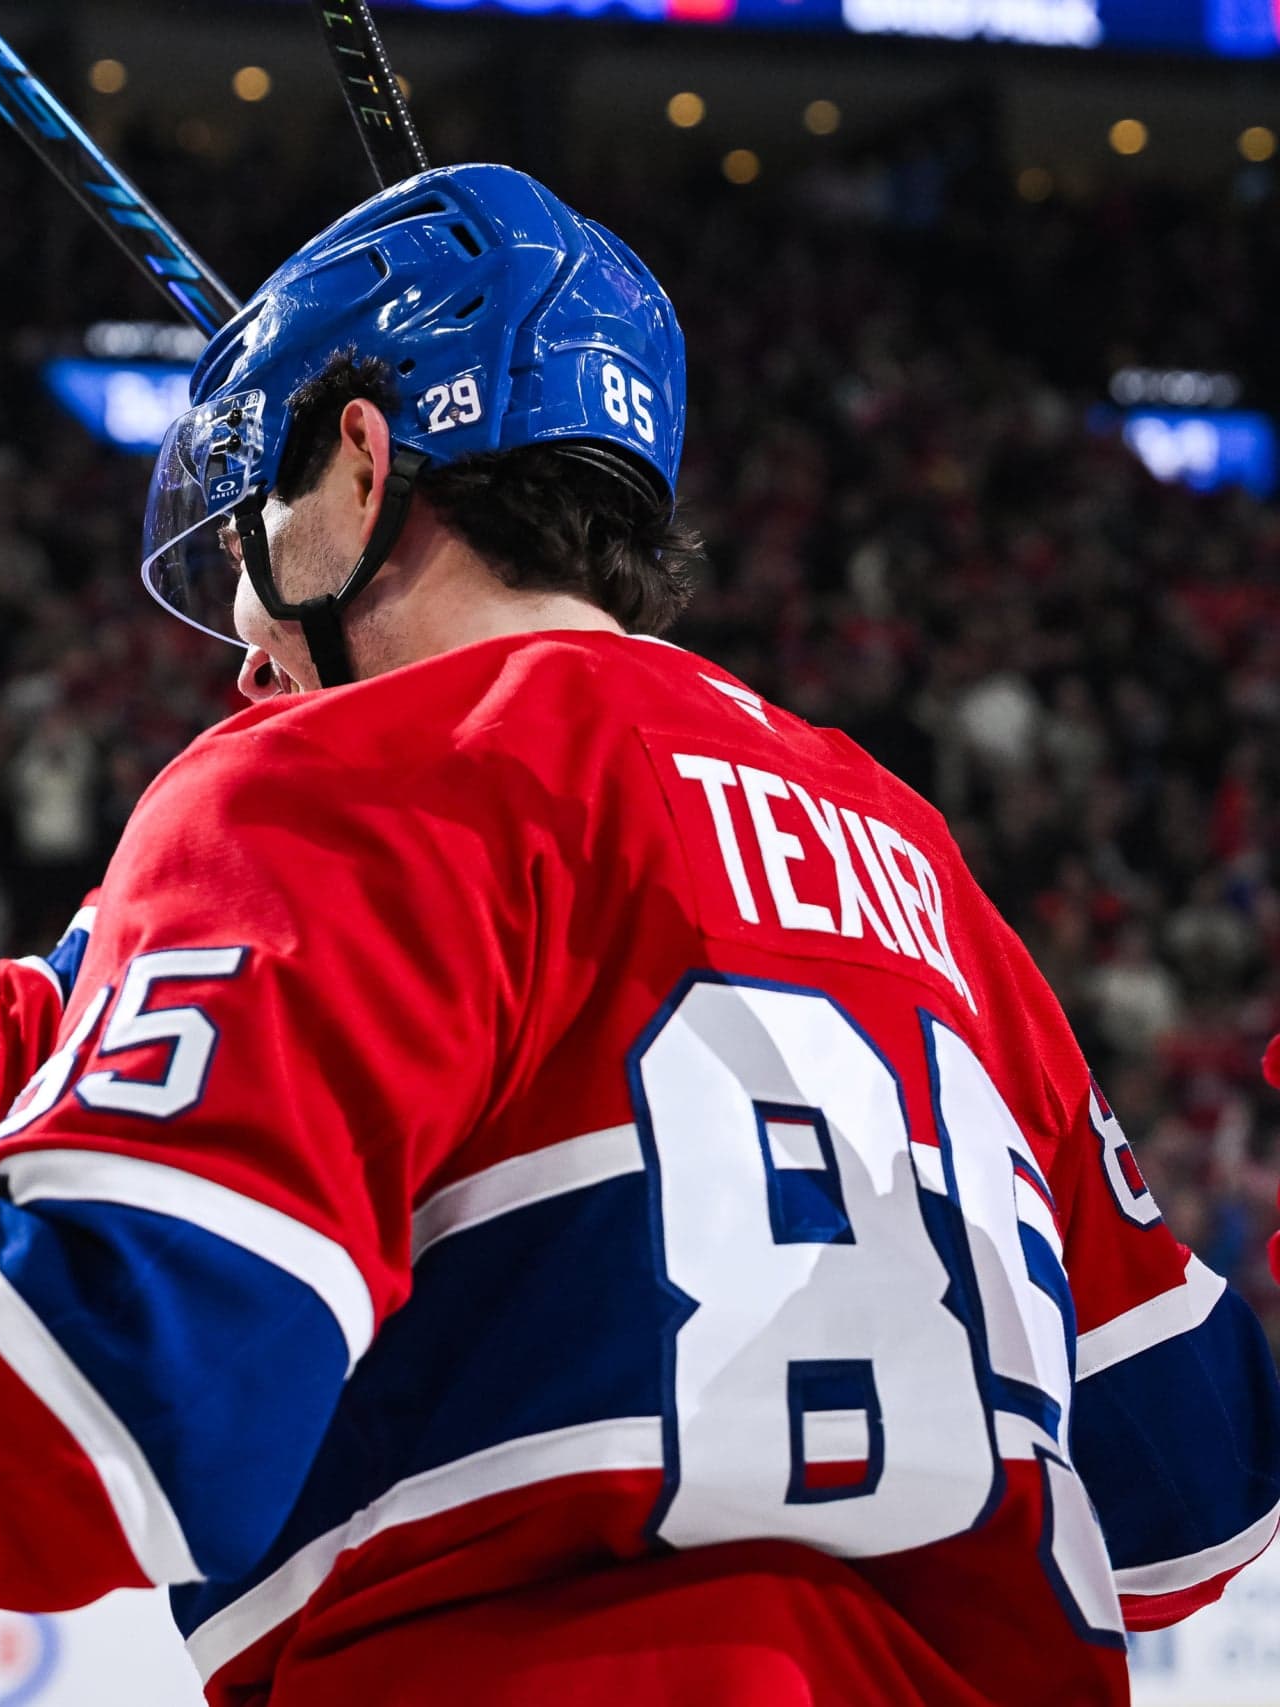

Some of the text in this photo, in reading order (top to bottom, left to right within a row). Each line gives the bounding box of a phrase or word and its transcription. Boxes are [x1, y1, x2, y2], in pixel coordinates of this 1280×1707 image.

[322, 0, 393, 131] LITE
[424, 372, 483, 435] 29
[600, 361, 656, 445] 85
[671, 752, 978, 1017] TEXIER
